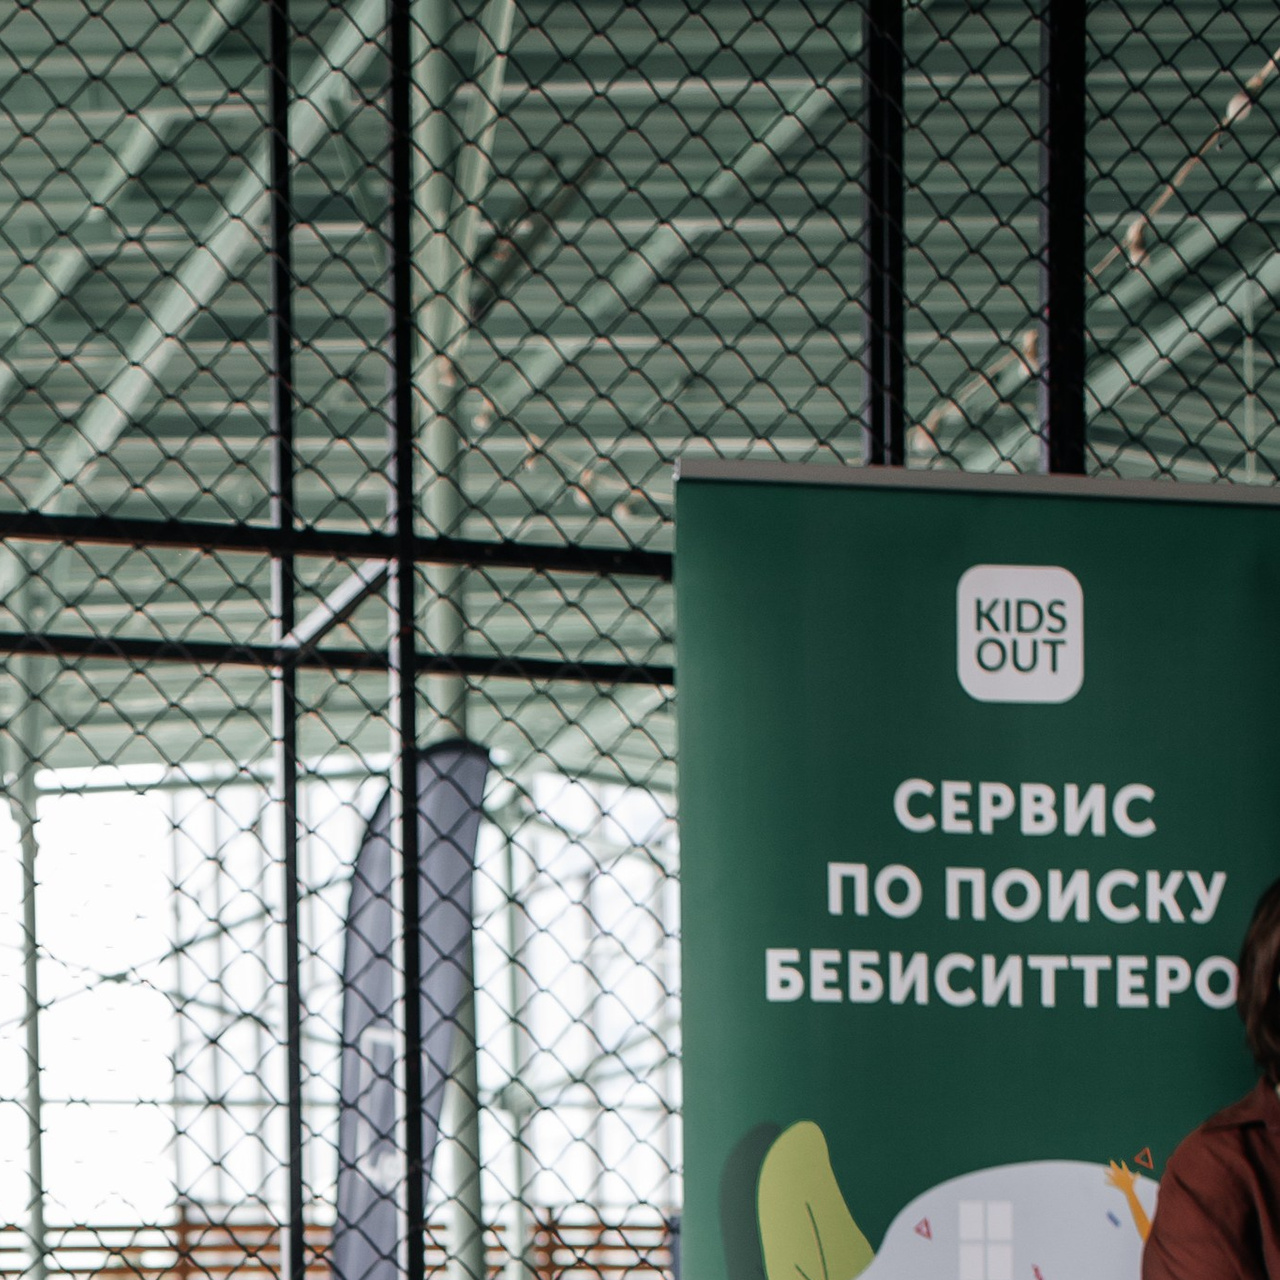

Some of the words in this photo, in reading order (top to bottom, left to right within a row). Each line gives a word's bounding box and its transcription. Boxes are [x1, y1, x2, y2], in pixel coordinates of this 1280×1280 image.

[974, 598, 1067, 634] KIDS
[975, 638, 1067, 673] OUT
[893, 777, 1157, 837] СЕРВИС
[827, 861, 922, 919] ПО
[944, 867, 1227, 924] ПОИСКУ
[765, 947, 1240, 1010] БЕБИСИТТЕРО
